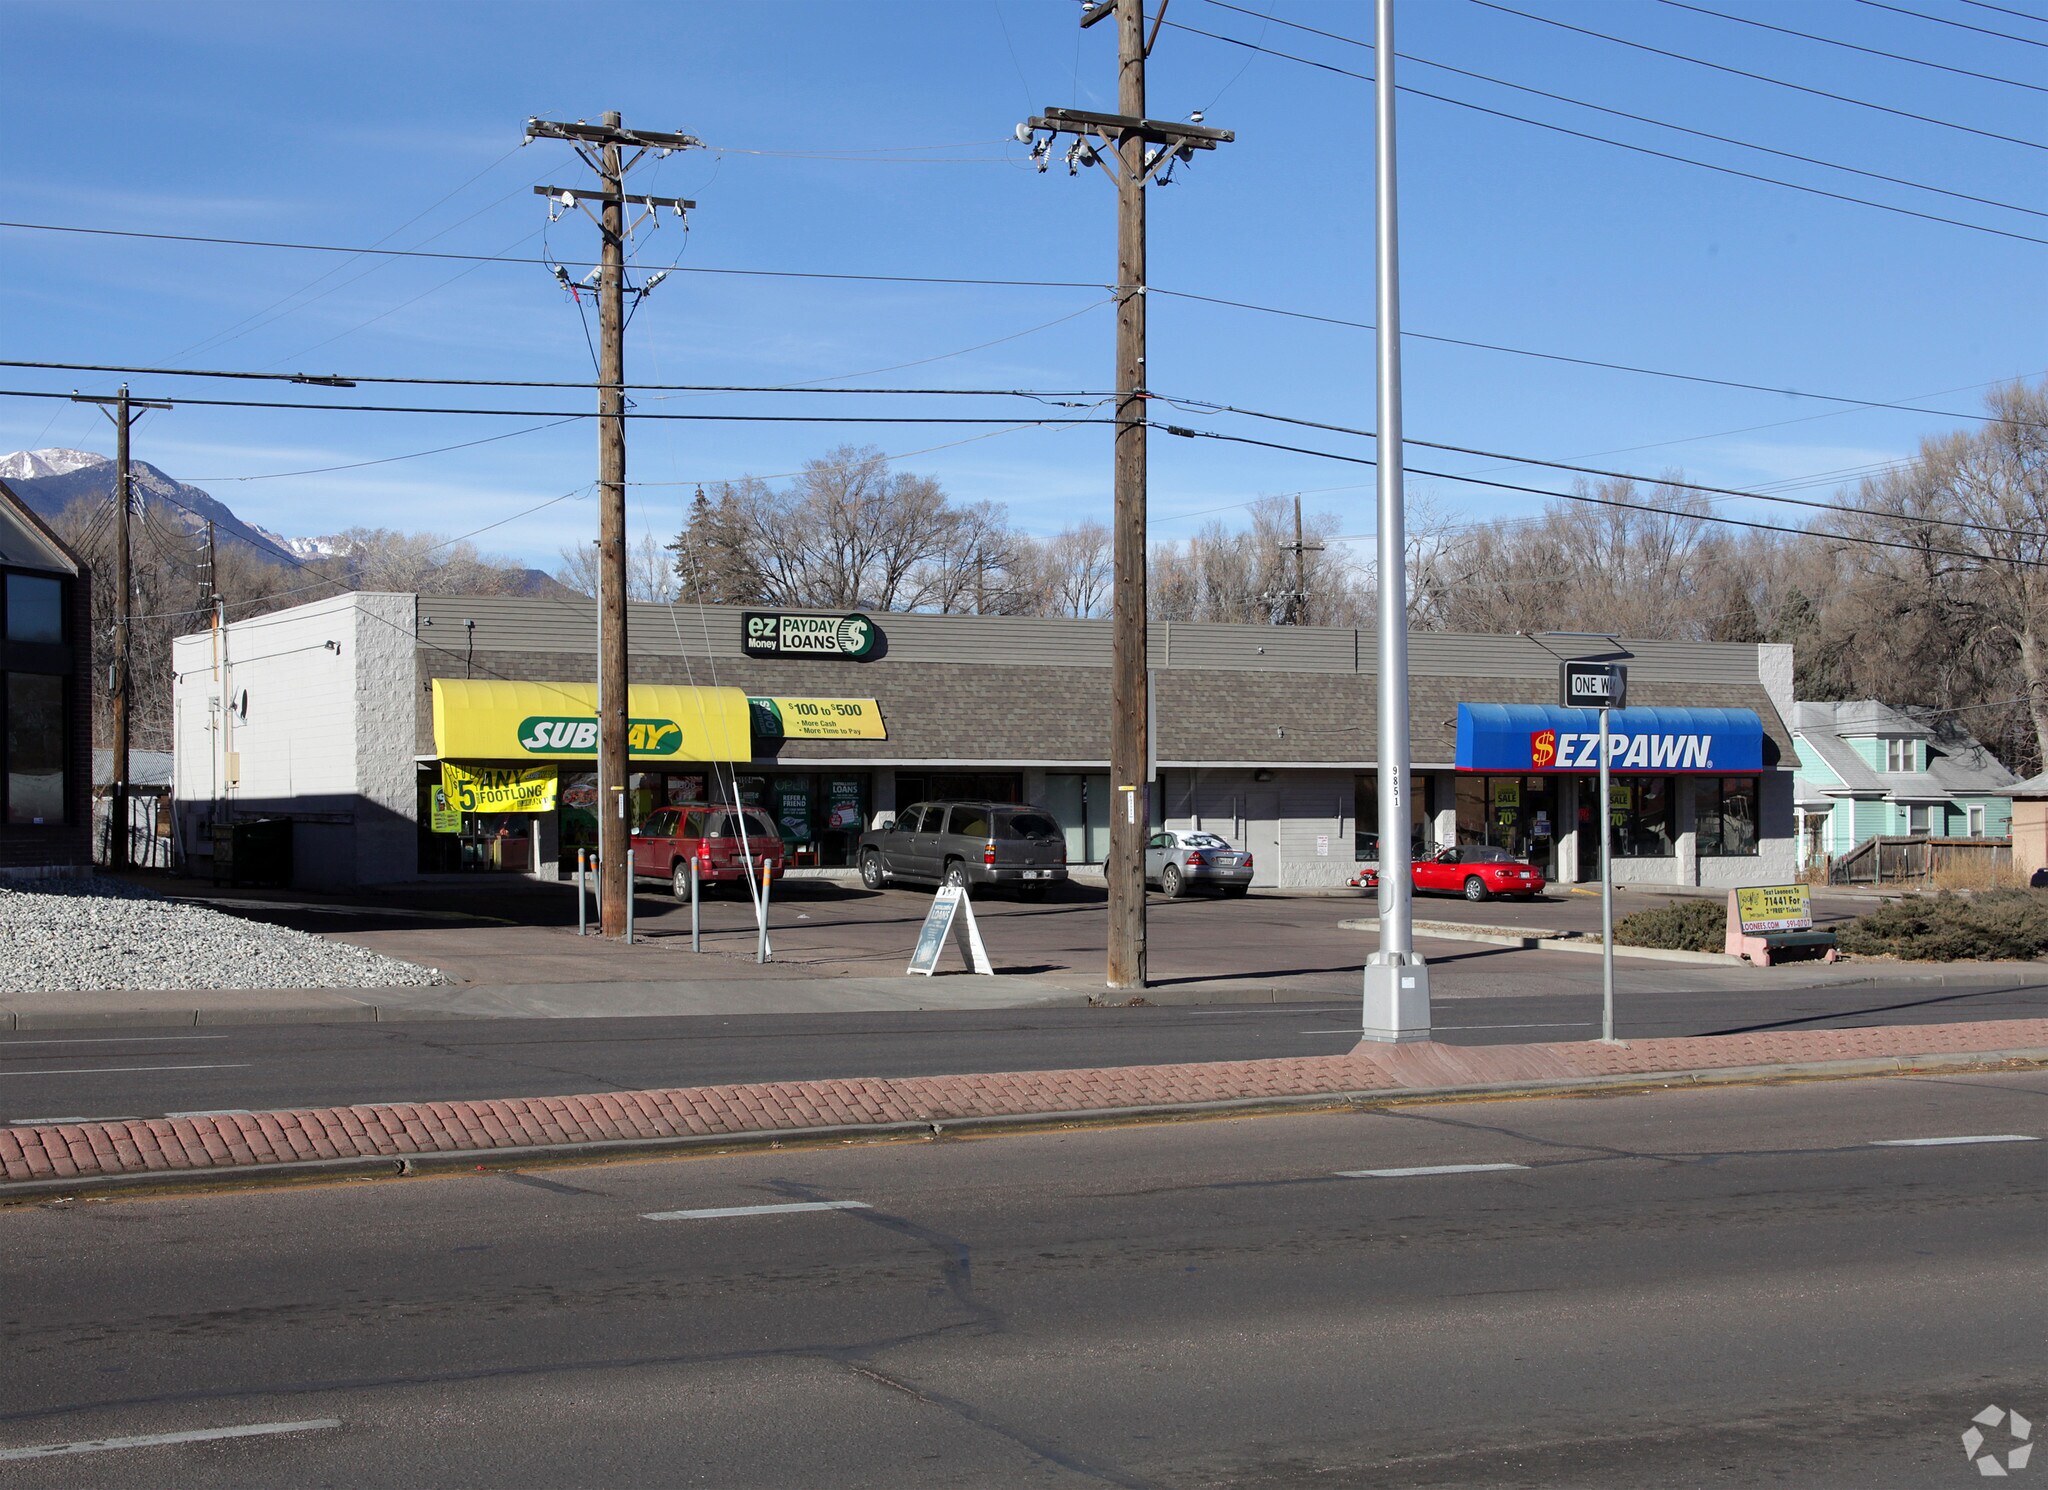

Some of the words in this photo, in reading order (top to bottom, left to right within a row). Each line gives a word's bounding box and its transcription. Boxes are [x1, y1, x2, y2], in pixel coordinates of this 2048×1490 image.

[748, 617, 777, 637] ez
[783, 619, 836, 633] PAYDAY
[748, 638, 777, 650] Money
[783, 635, 836, 649] LOANS
[1575, 676, 1597, 694] ONE
[788, 702, 818, 715] $100
[820, 706, 831, 716] to
[831, 703, 862, 716] $500
[521, 721, 680, 750] SUBAY
[1554, 734, 1712, 768] EZPAWN
[480, 769, 526, 790] ANY
[480, 785, 542, 804] FOOTLONG
[1498, 794, 1517, 802] SALE
[1610, 796, 1628, 804] SALE
[1764, 896, 1787, 906] 71441
[1789, 896, 1800, 905] For
[931, 910, 951, 920] LOANS
[1786, 919, 1810, 928] 591-0707
